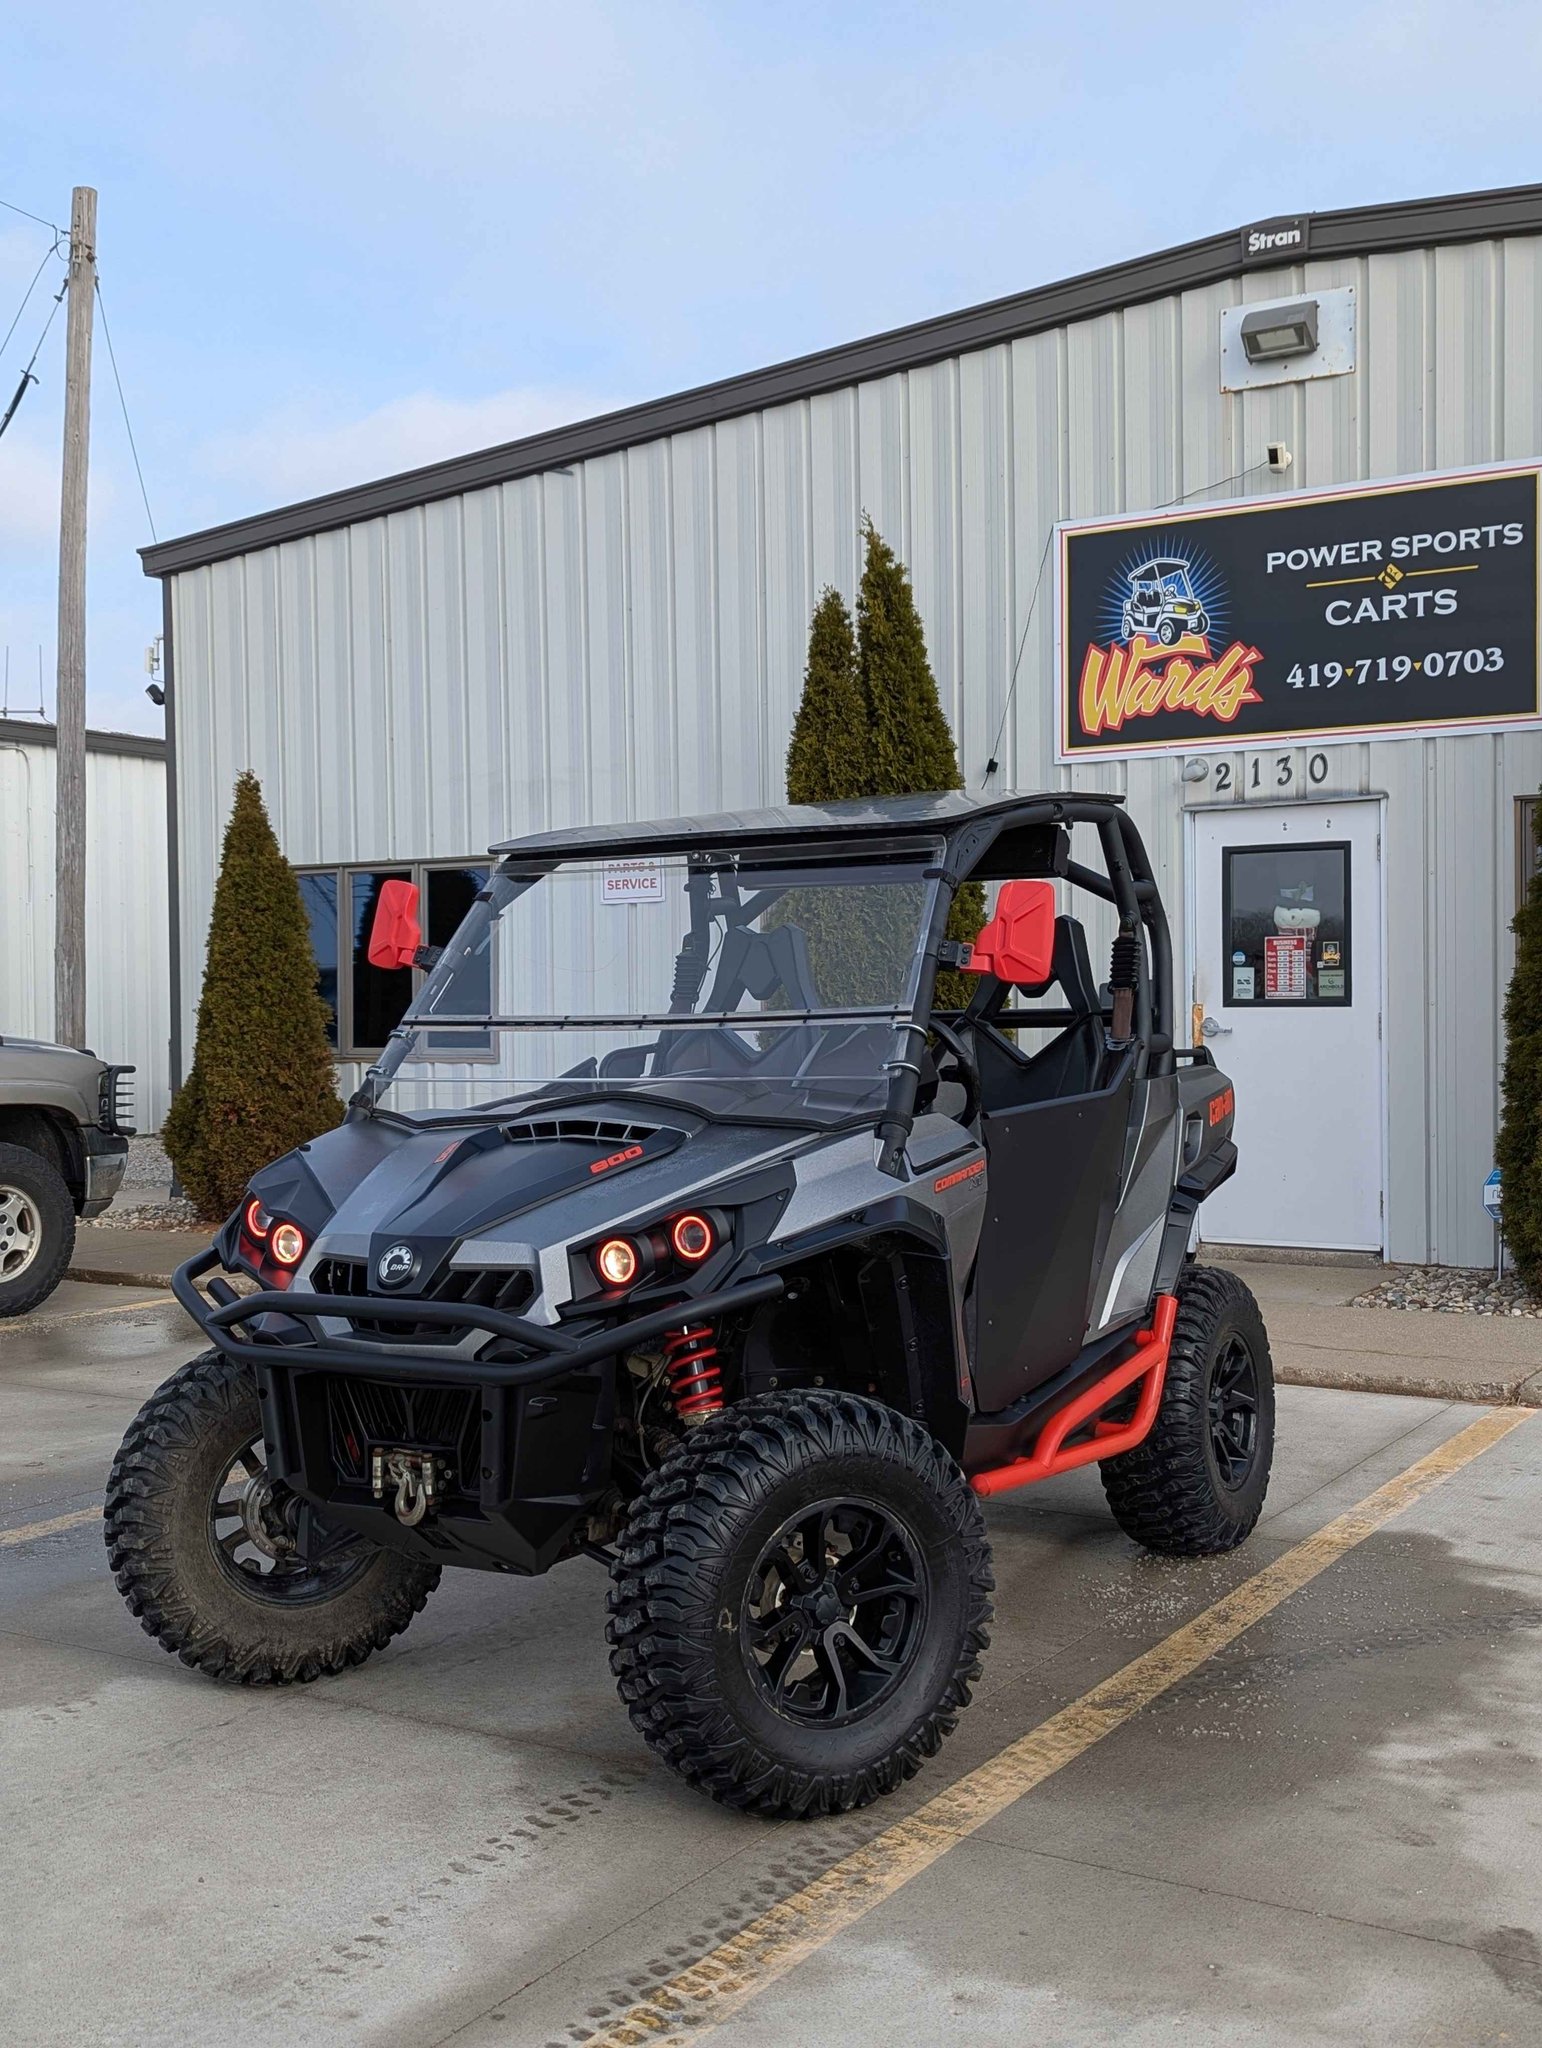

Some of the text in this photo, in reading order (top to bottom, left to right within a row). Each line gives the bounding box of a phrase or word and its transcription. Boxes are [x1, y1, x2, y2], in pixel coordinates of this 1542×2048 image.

[1248, 229, 1300, 251] Stran
[1266, 522, 1524, 574] POWER SPORTS
[1325, 588, 1458, 626] CARTS
[1081, 637, 1261, 735] Ward's
[1215, 753, 1328, 792] 2130
[607, 878, 657, 890] SERVICE
[590, 1145, 643, 1174] 800
[390, 1263, 409, 1271] BRP
